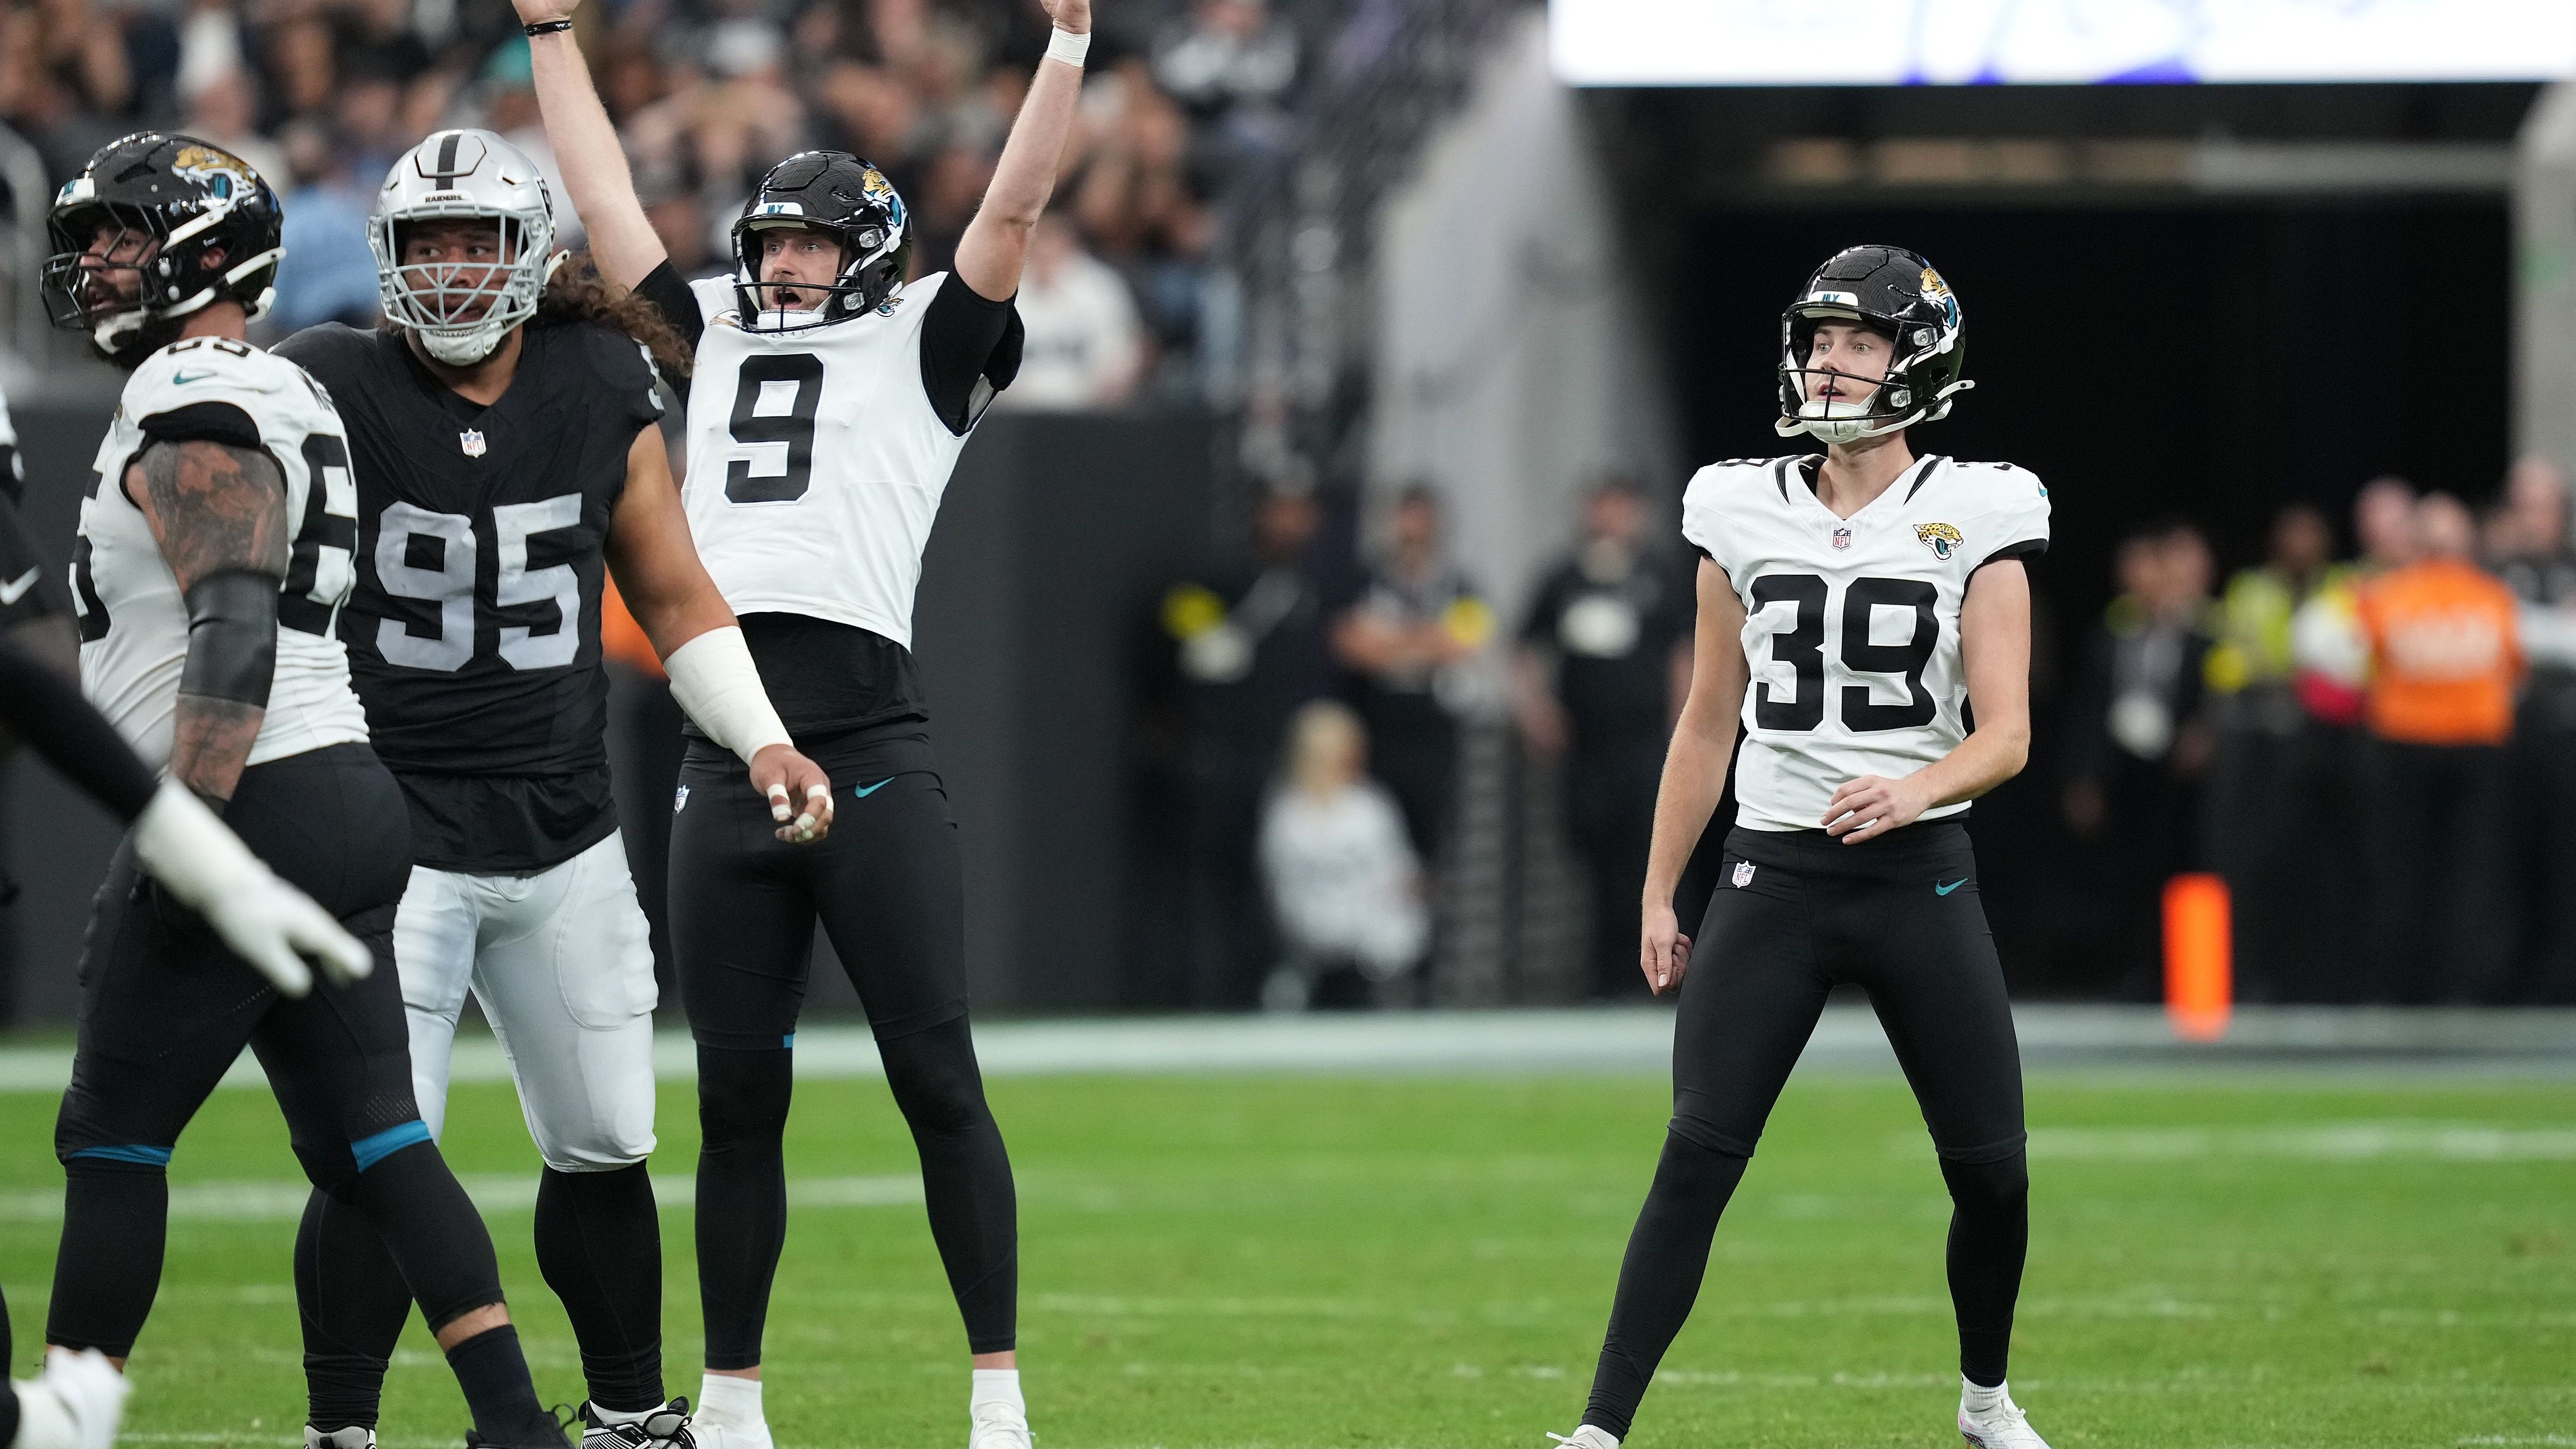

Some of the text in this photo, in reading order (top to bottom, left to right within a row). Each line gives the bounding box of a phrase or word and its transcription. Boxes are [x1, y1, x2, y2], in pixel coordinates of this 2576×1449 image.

[425, 195, 462, 203] RAIDERS
[724, 353, 825, 504] 9
[466, 441, 482, 451] NFL
[1835, 536, 1849, 547] NFL
[375, 492, 582, 672] 95
[1749, 574, 1941, 732] 39
[1735, 873, 1748, 883] NFL
